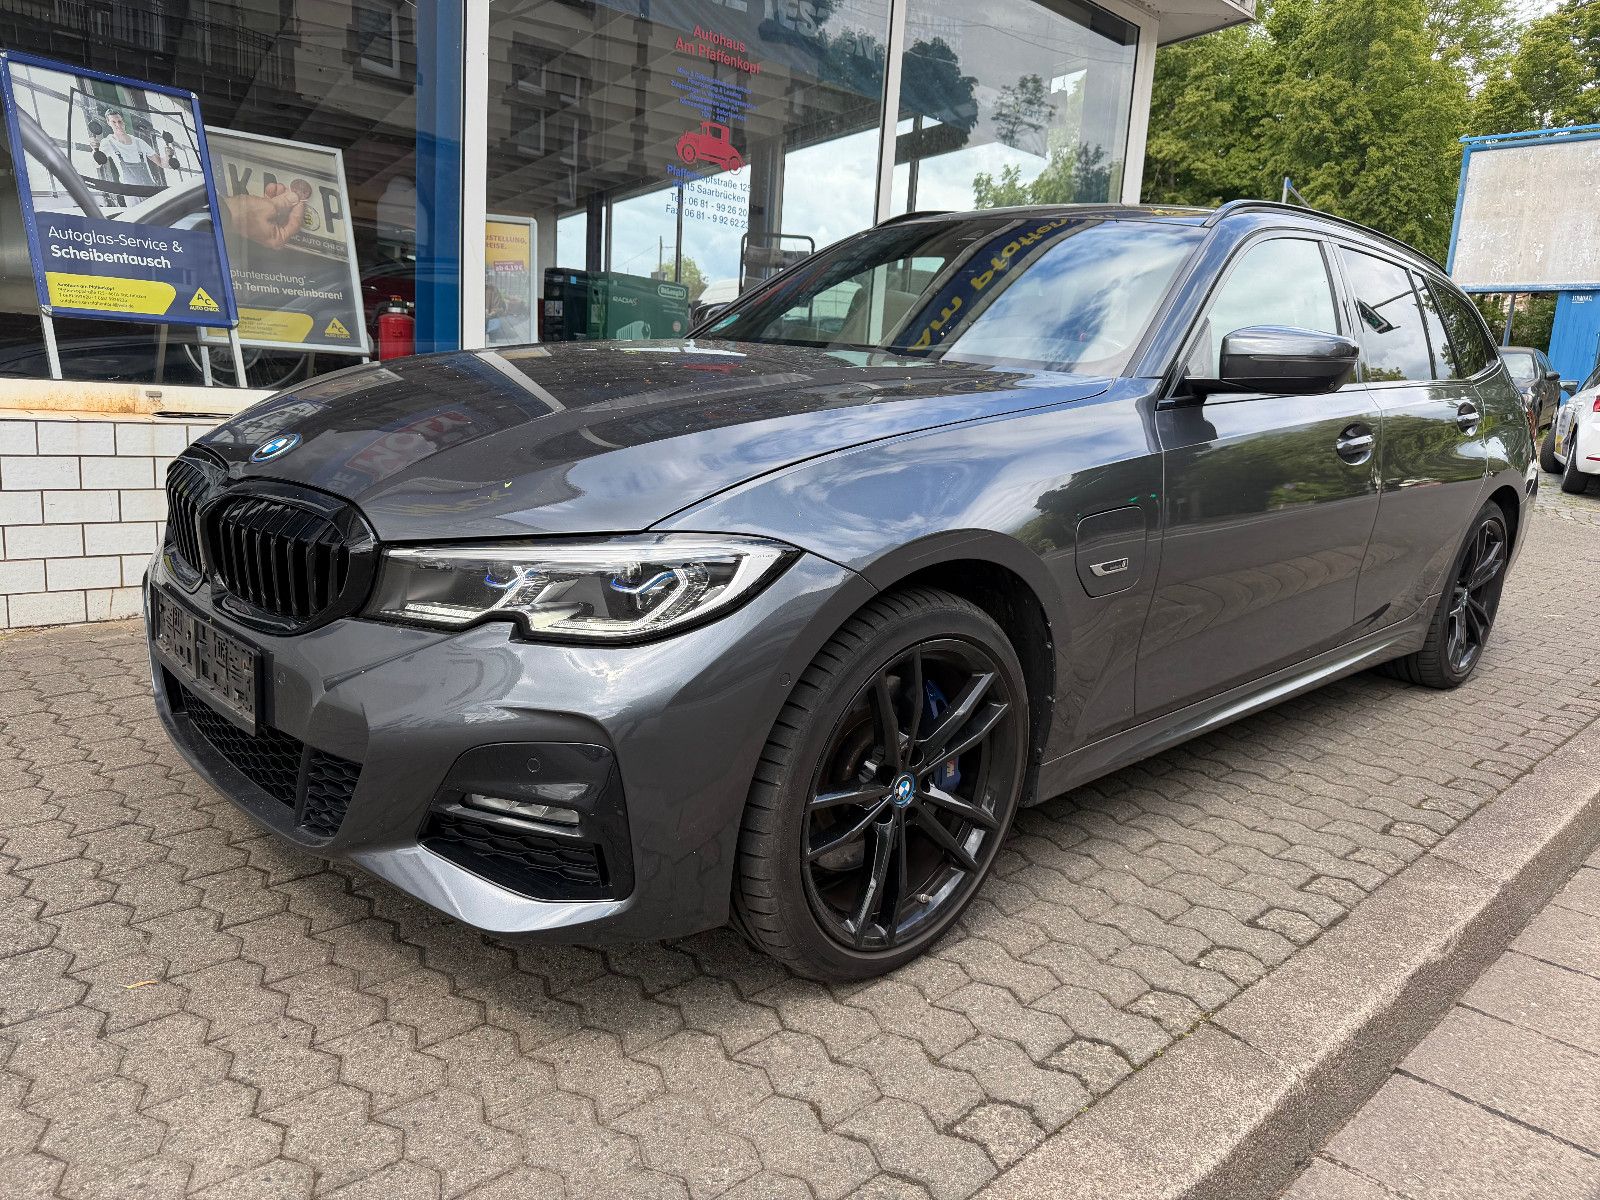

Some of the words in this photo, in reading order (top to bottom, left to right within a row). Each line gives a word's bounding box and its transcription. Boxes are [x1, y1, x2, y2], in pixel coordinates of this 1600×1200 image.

[693, 24, 746, 53] Autohaus
[675, 36, 696, 55] Am
[698, 43, 762, 75] Pfaffenkopf
[696, 184, 746, 204] Saarbrücken
[684, 207, 695, 218] 06
[719, 215, 729, 226] 92
[688, 196, 699, 207] 06
[700, 200, 709, 209] 81
[716, 203, 726, 213] 99
[727, 205, 737, 215] 26
[738, 208, 748, 217] 20
[49, 225, 168, 251] Autoglas-Service
[172, 240, 184, 253] &
[302, 236, 320, 246] AUTO
[50, 244, 172, 269] Scheibentausch
[245, 281, 280, 294] Termin
[281, 287, 343, 300] vereinbaren!
